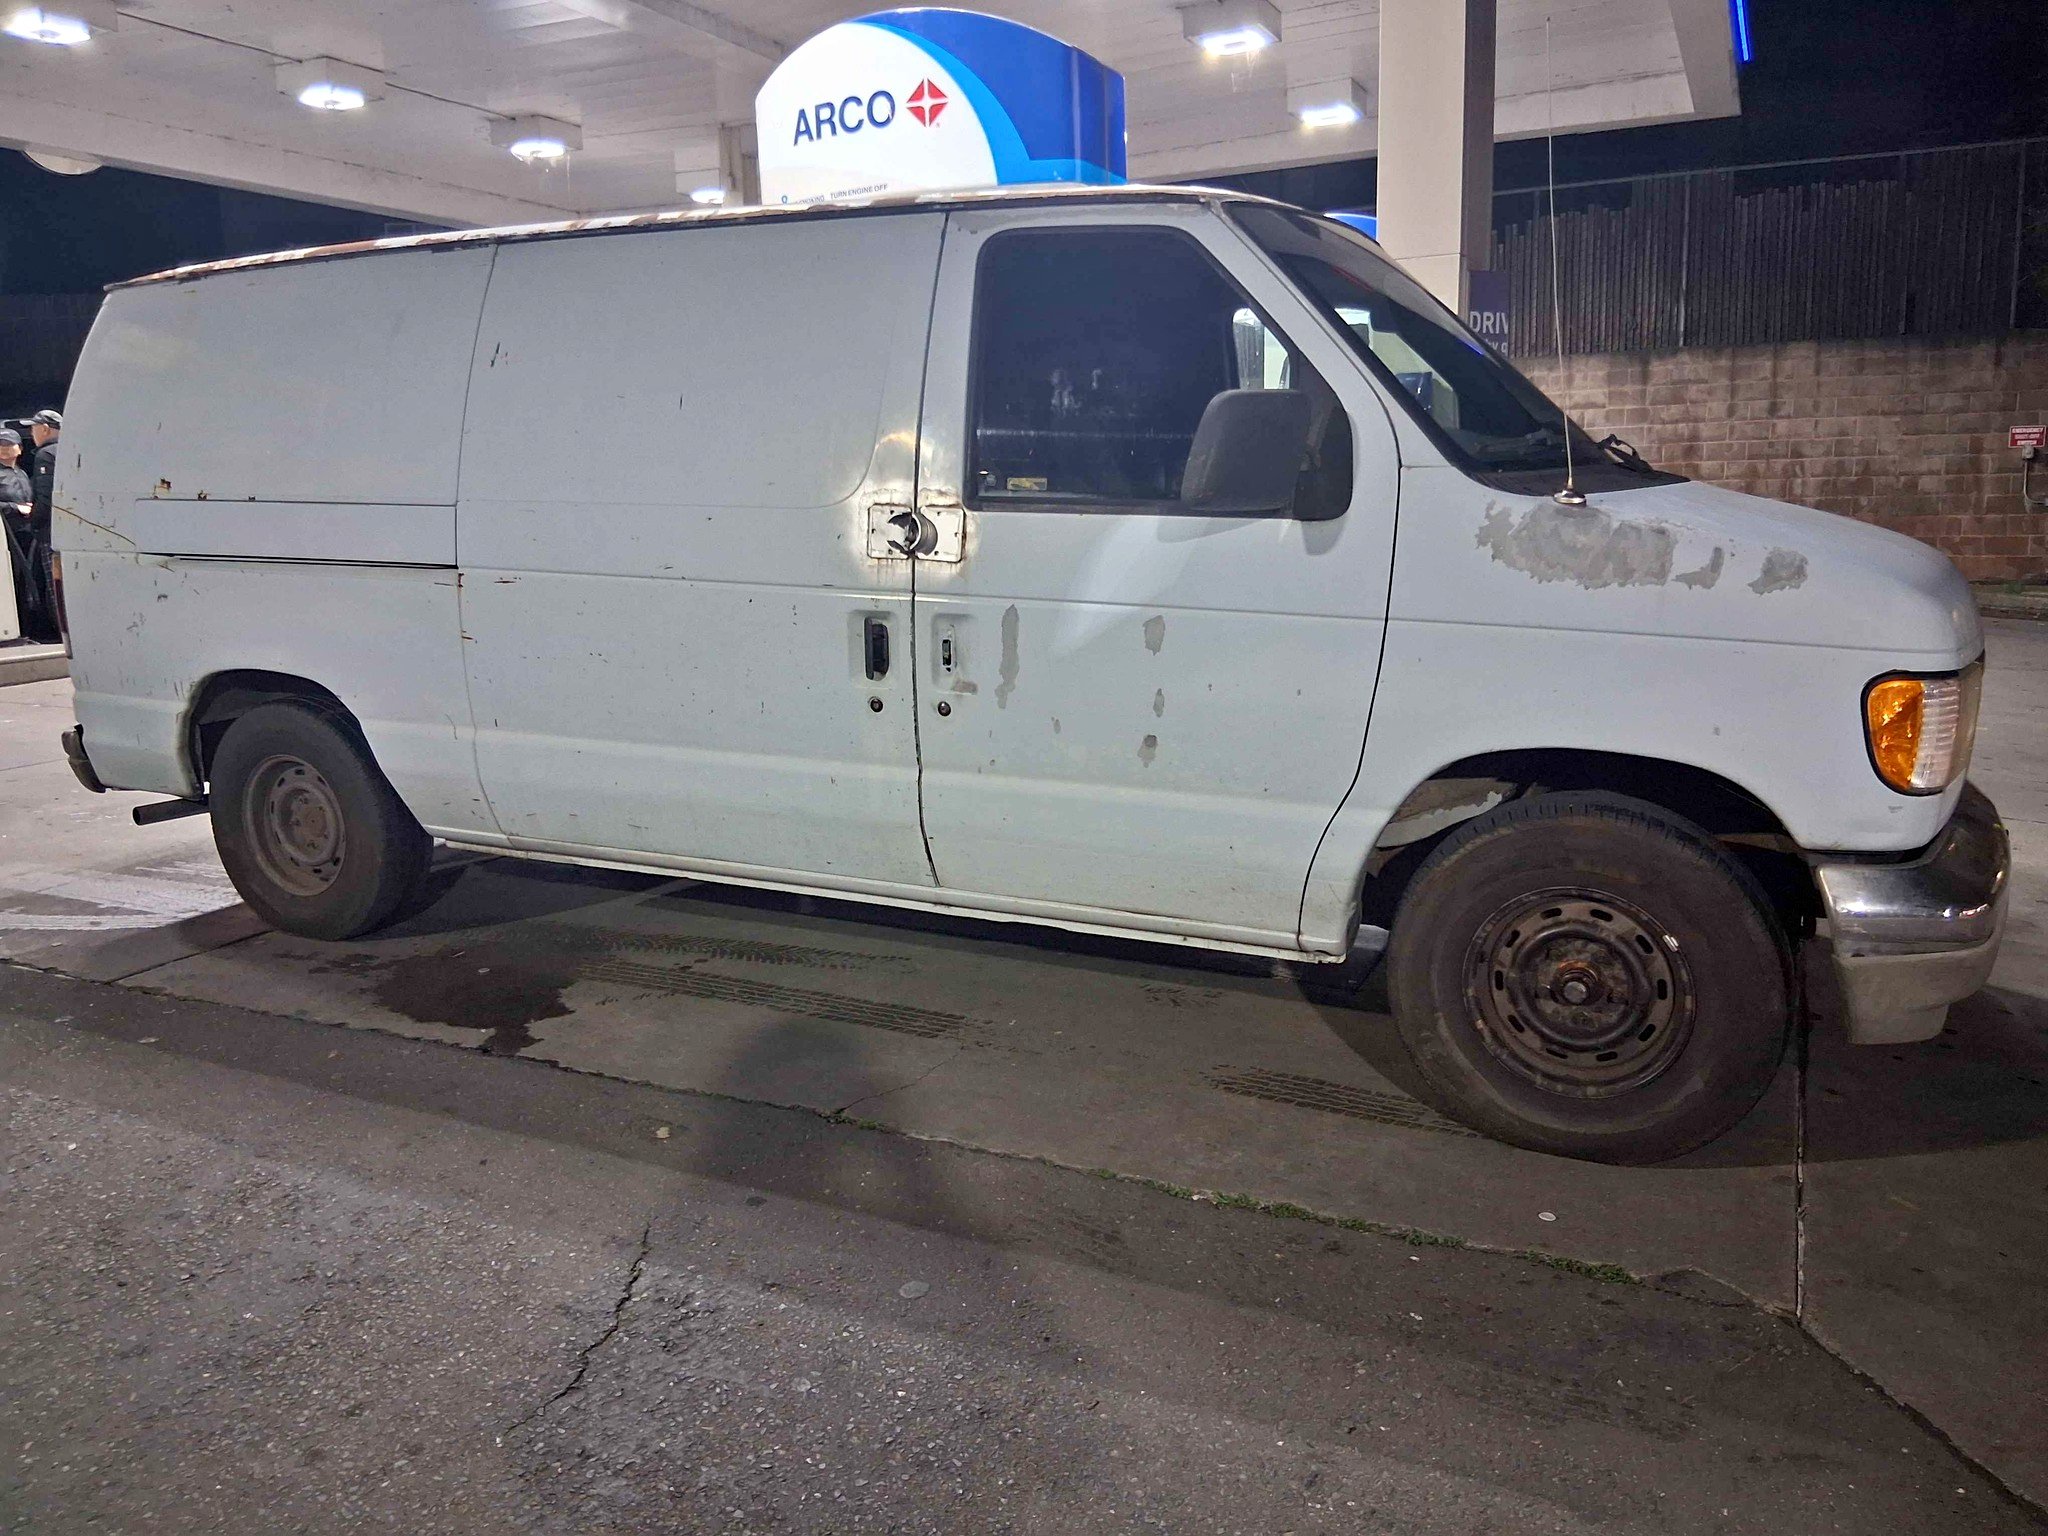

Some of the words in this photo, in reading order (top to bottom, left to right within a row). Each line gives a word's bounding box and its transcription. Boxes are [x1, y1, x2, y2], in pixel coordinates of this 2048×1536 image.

[793, 90, 895, 146] ARCO
[830, 190, 847, 199] TURN
[847, 185, 873, 195] ENGINE
[873, 183, 888, 192] OFF
